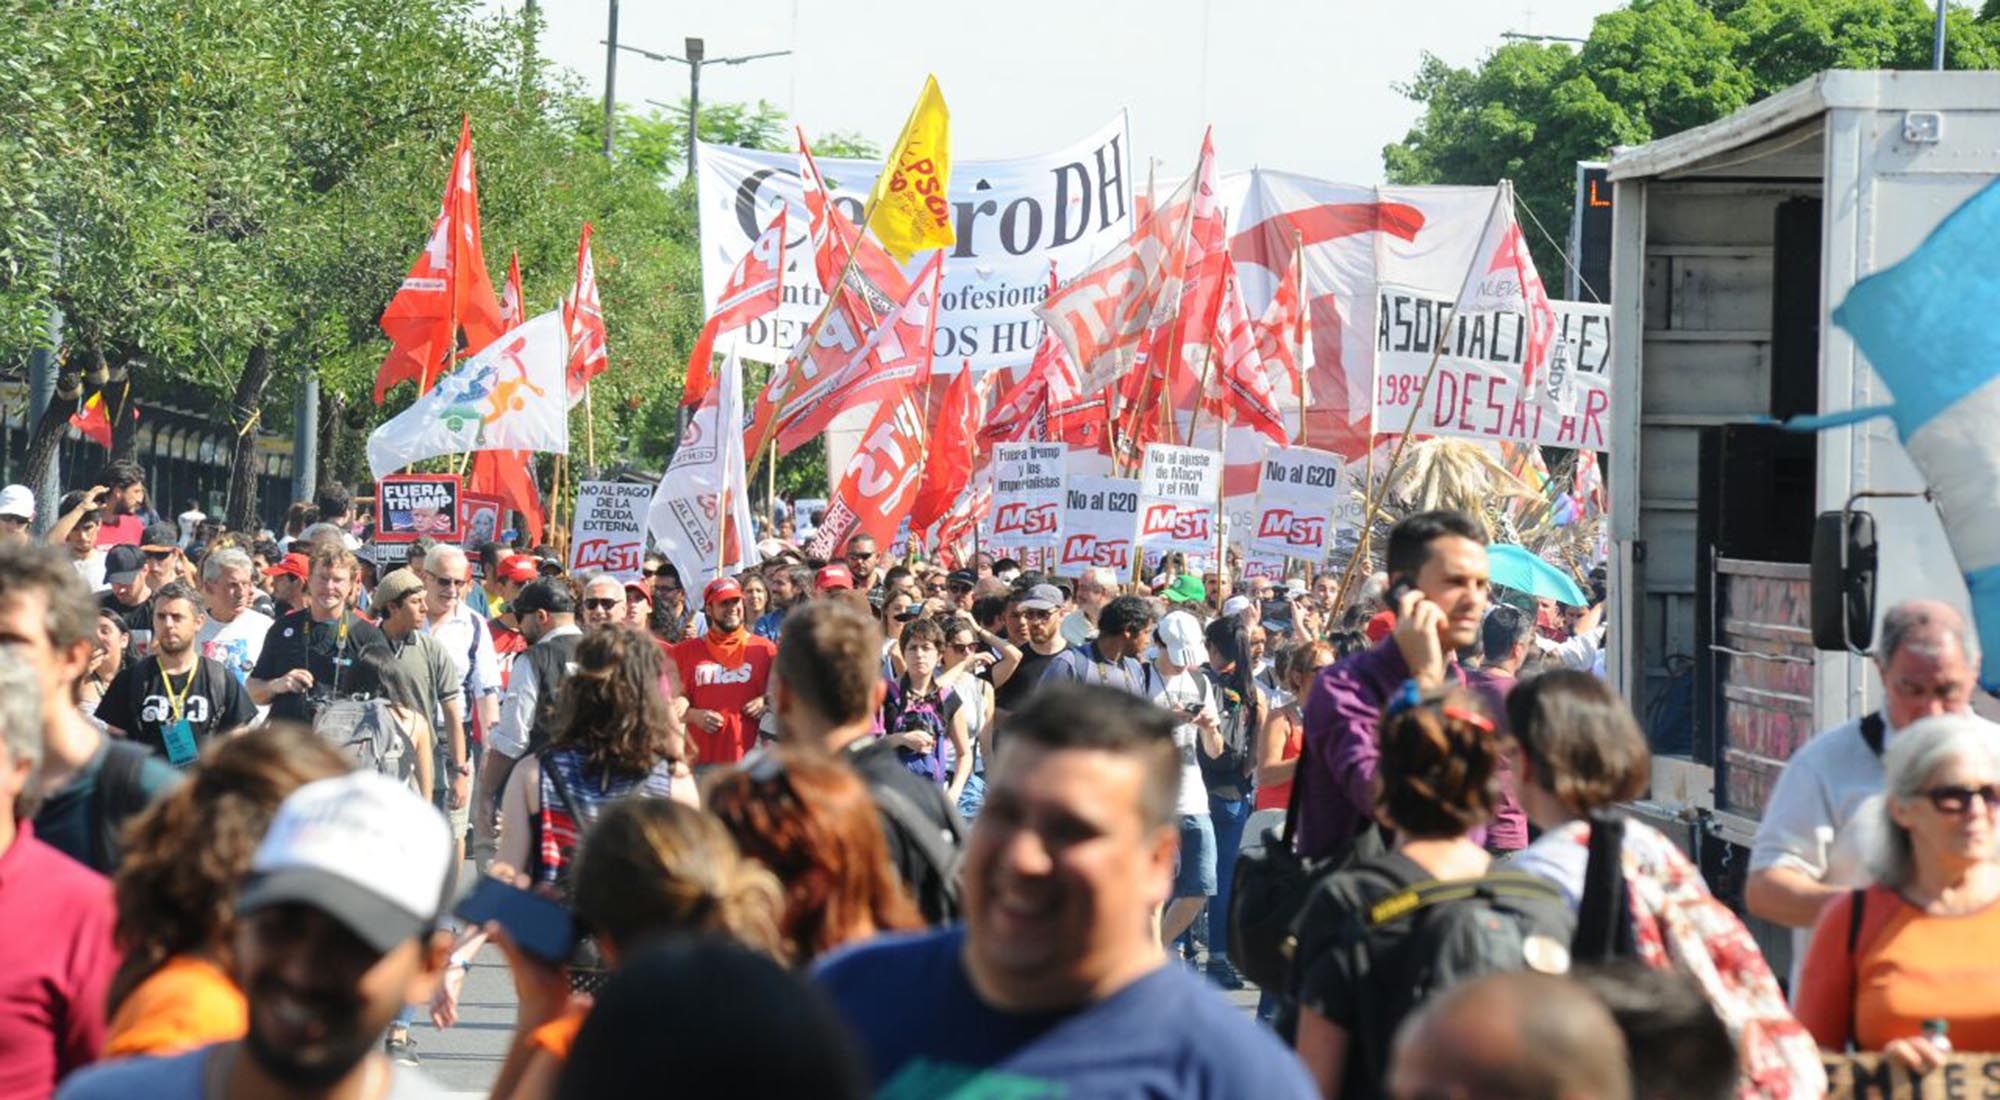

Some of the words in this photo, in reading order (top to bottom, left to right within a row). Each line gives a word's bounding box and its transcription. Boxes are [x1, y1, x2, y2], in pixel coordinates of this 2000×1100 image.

[1000, 447, 1027, 461] Fuera
[1030, 446, 1060, 459] Trump
[1151, 450, 1165, 463] No
[1167, 451, 1177, 464] al
[1180, 453, 1210, 467] ajuste
[1026, 462, 1041, 474] los
[1155, 465, 1168, 479] de
[1171, 466, 1203, 481] Macri
[1266, 460, 1286, 482] No
[1290, 464, 1303, 484] al
[1306, 465, 1337, 488] G20
[384, 483, 448, 498] FUERA
[580, 485, 598, 497] NO
[599, 485, 615, 497] AL
[617, 486, 650, 498] PAGO
[1167, 482, 1177, 495] el
[1180, 482, 1200, 496] FMI
[385, 496, 452, 511] TRUMP
[596, 497, 612, 508] DE
[614, 497, 630, 508] LA
[1066, 489, 1087, 511] No
[1091, 491, 1105, 511] al
[1109, 492, 1137, 513] G20
[591, 508, 633, 521] DEUDA
[994, 502, 1059, 534] MST
[1143, 504, 1210, 540] MST
[582, 521, 640, 533] EXTERNA
[1258, 508, 1326, 547] MST
[574, 538, 641, 571] MST
[1061, 533, 1129, 570] MST
